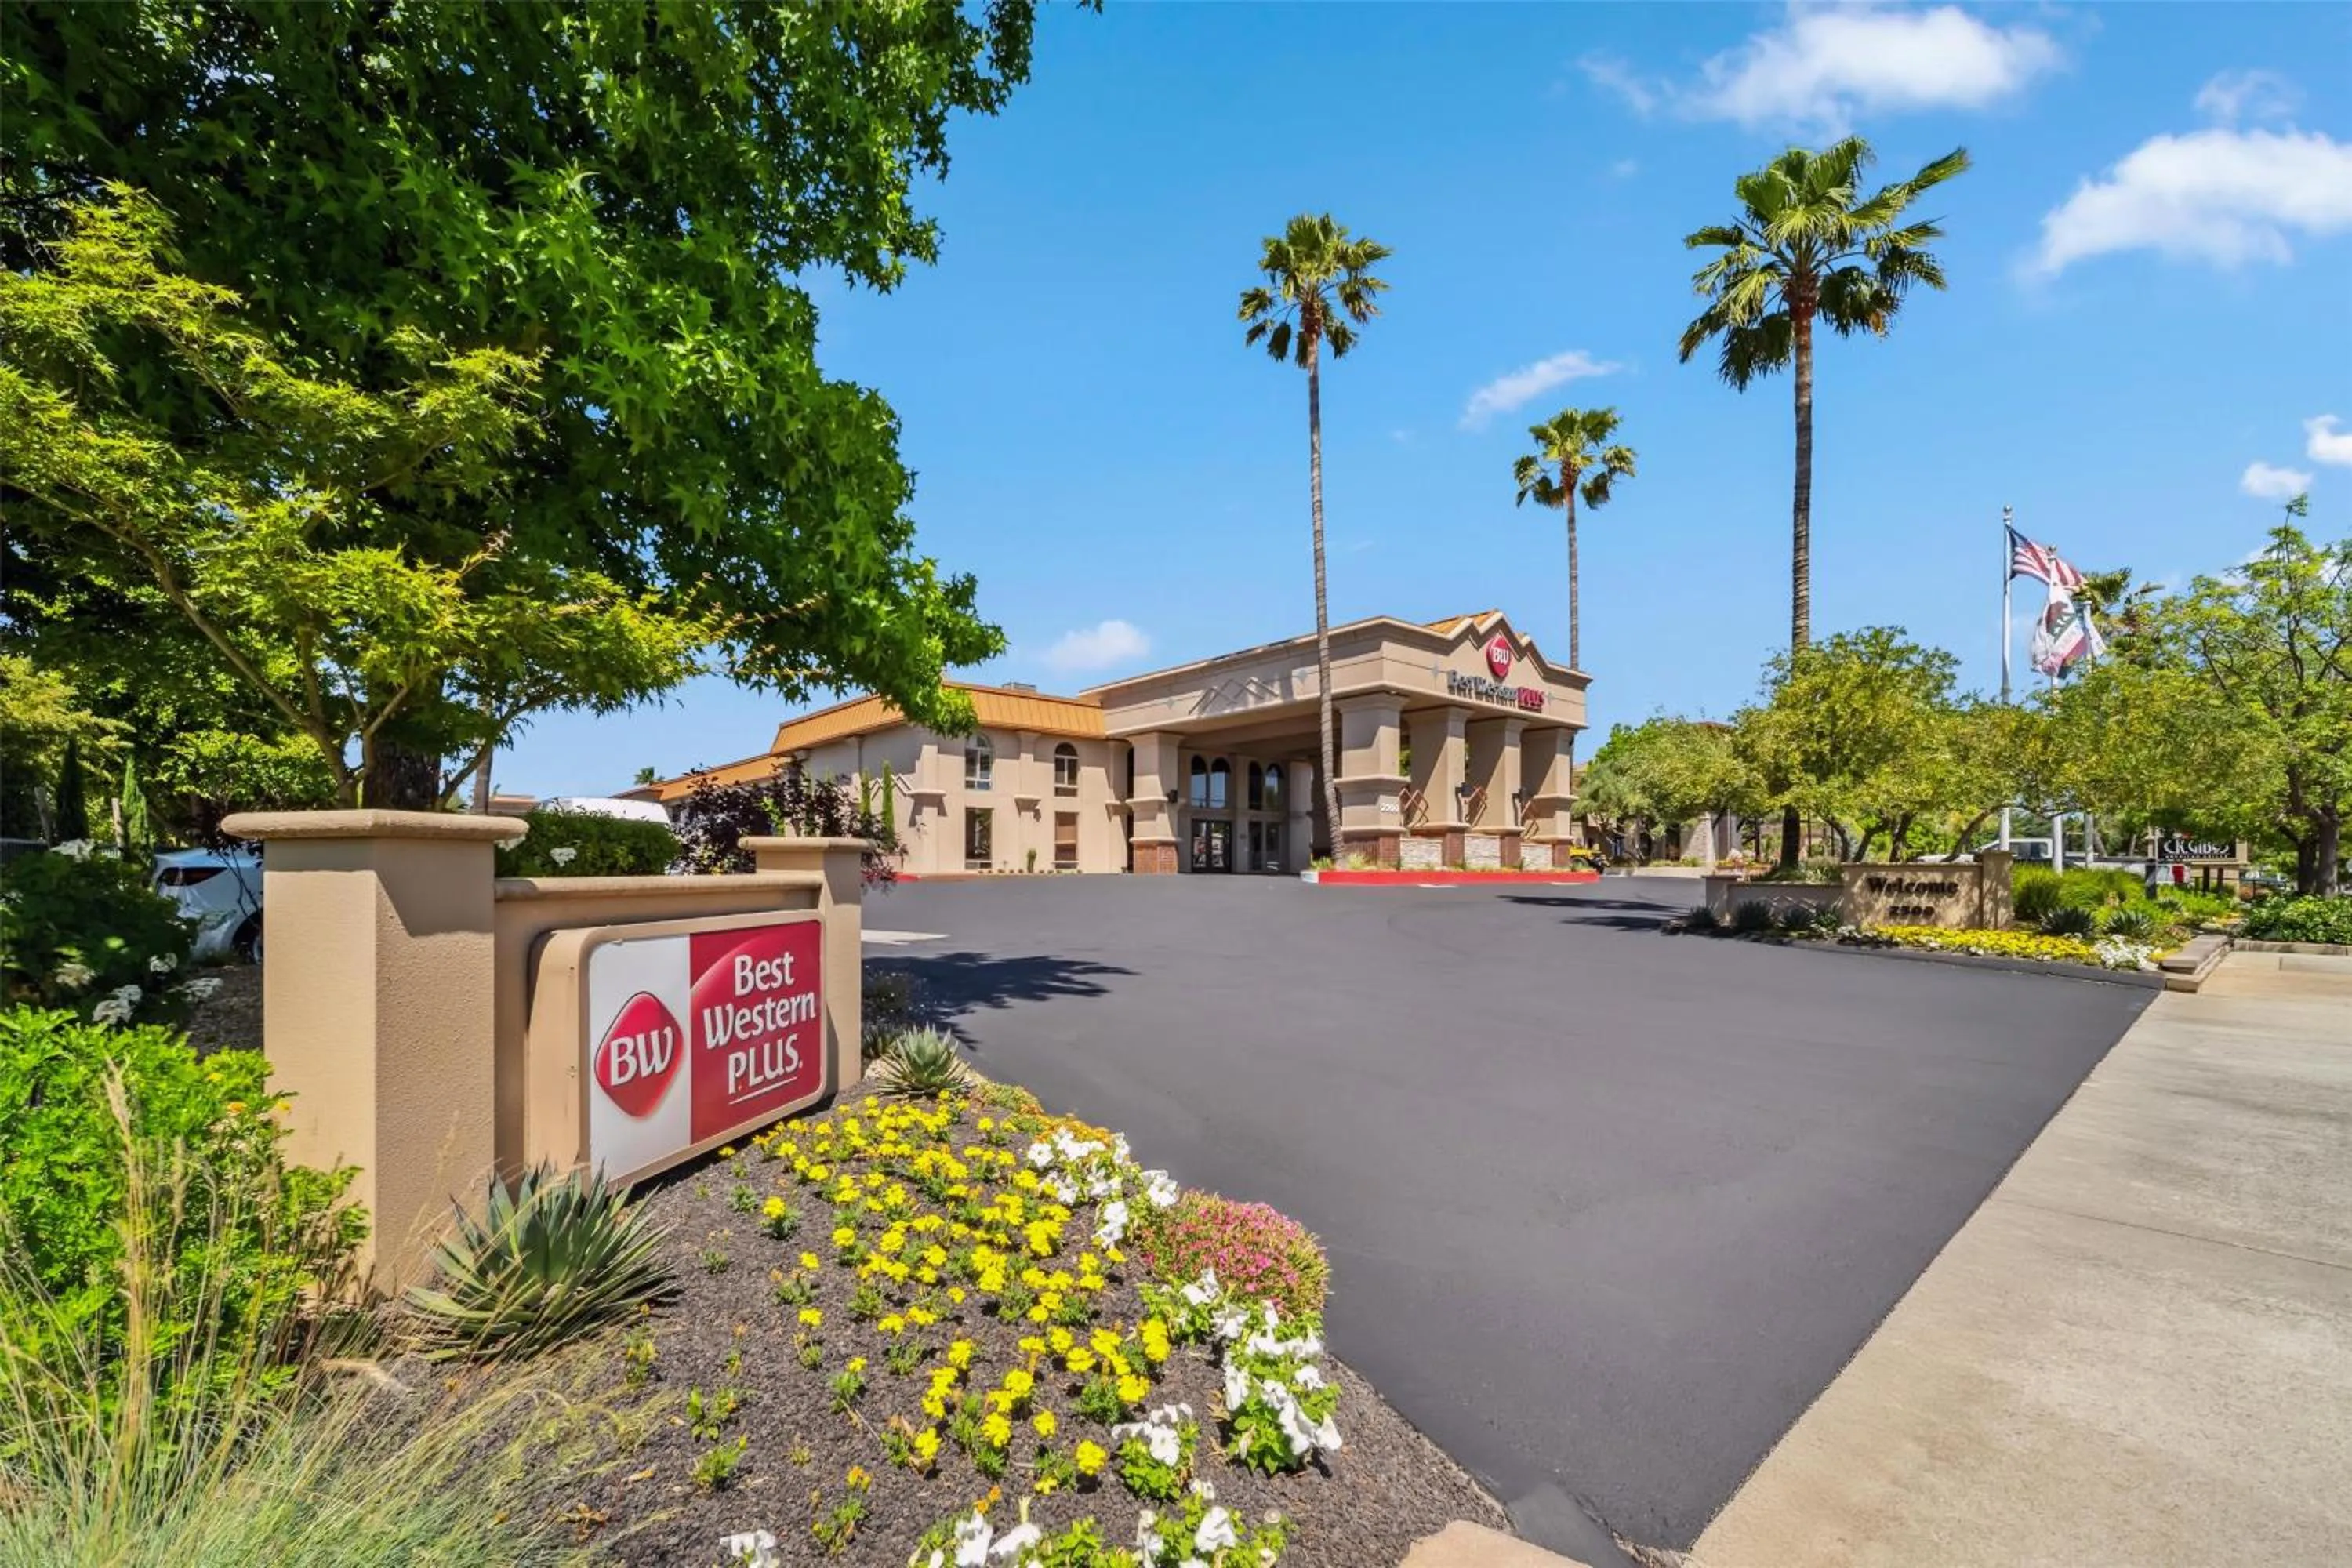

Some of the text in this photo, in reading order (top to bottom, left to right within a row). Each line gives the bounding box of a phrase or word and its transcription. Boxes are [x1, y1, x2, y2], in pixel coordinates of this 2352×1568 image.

[1492, 647, 1508, 664] BW
[1517, 687, 1544, 707] PLUS
[1865, 877, 1958, 896] Welcome
[735, 952, 795, 996] Best
[703, 991, 816, 1050] Western
[610, 1027, 674, 1087] BW
